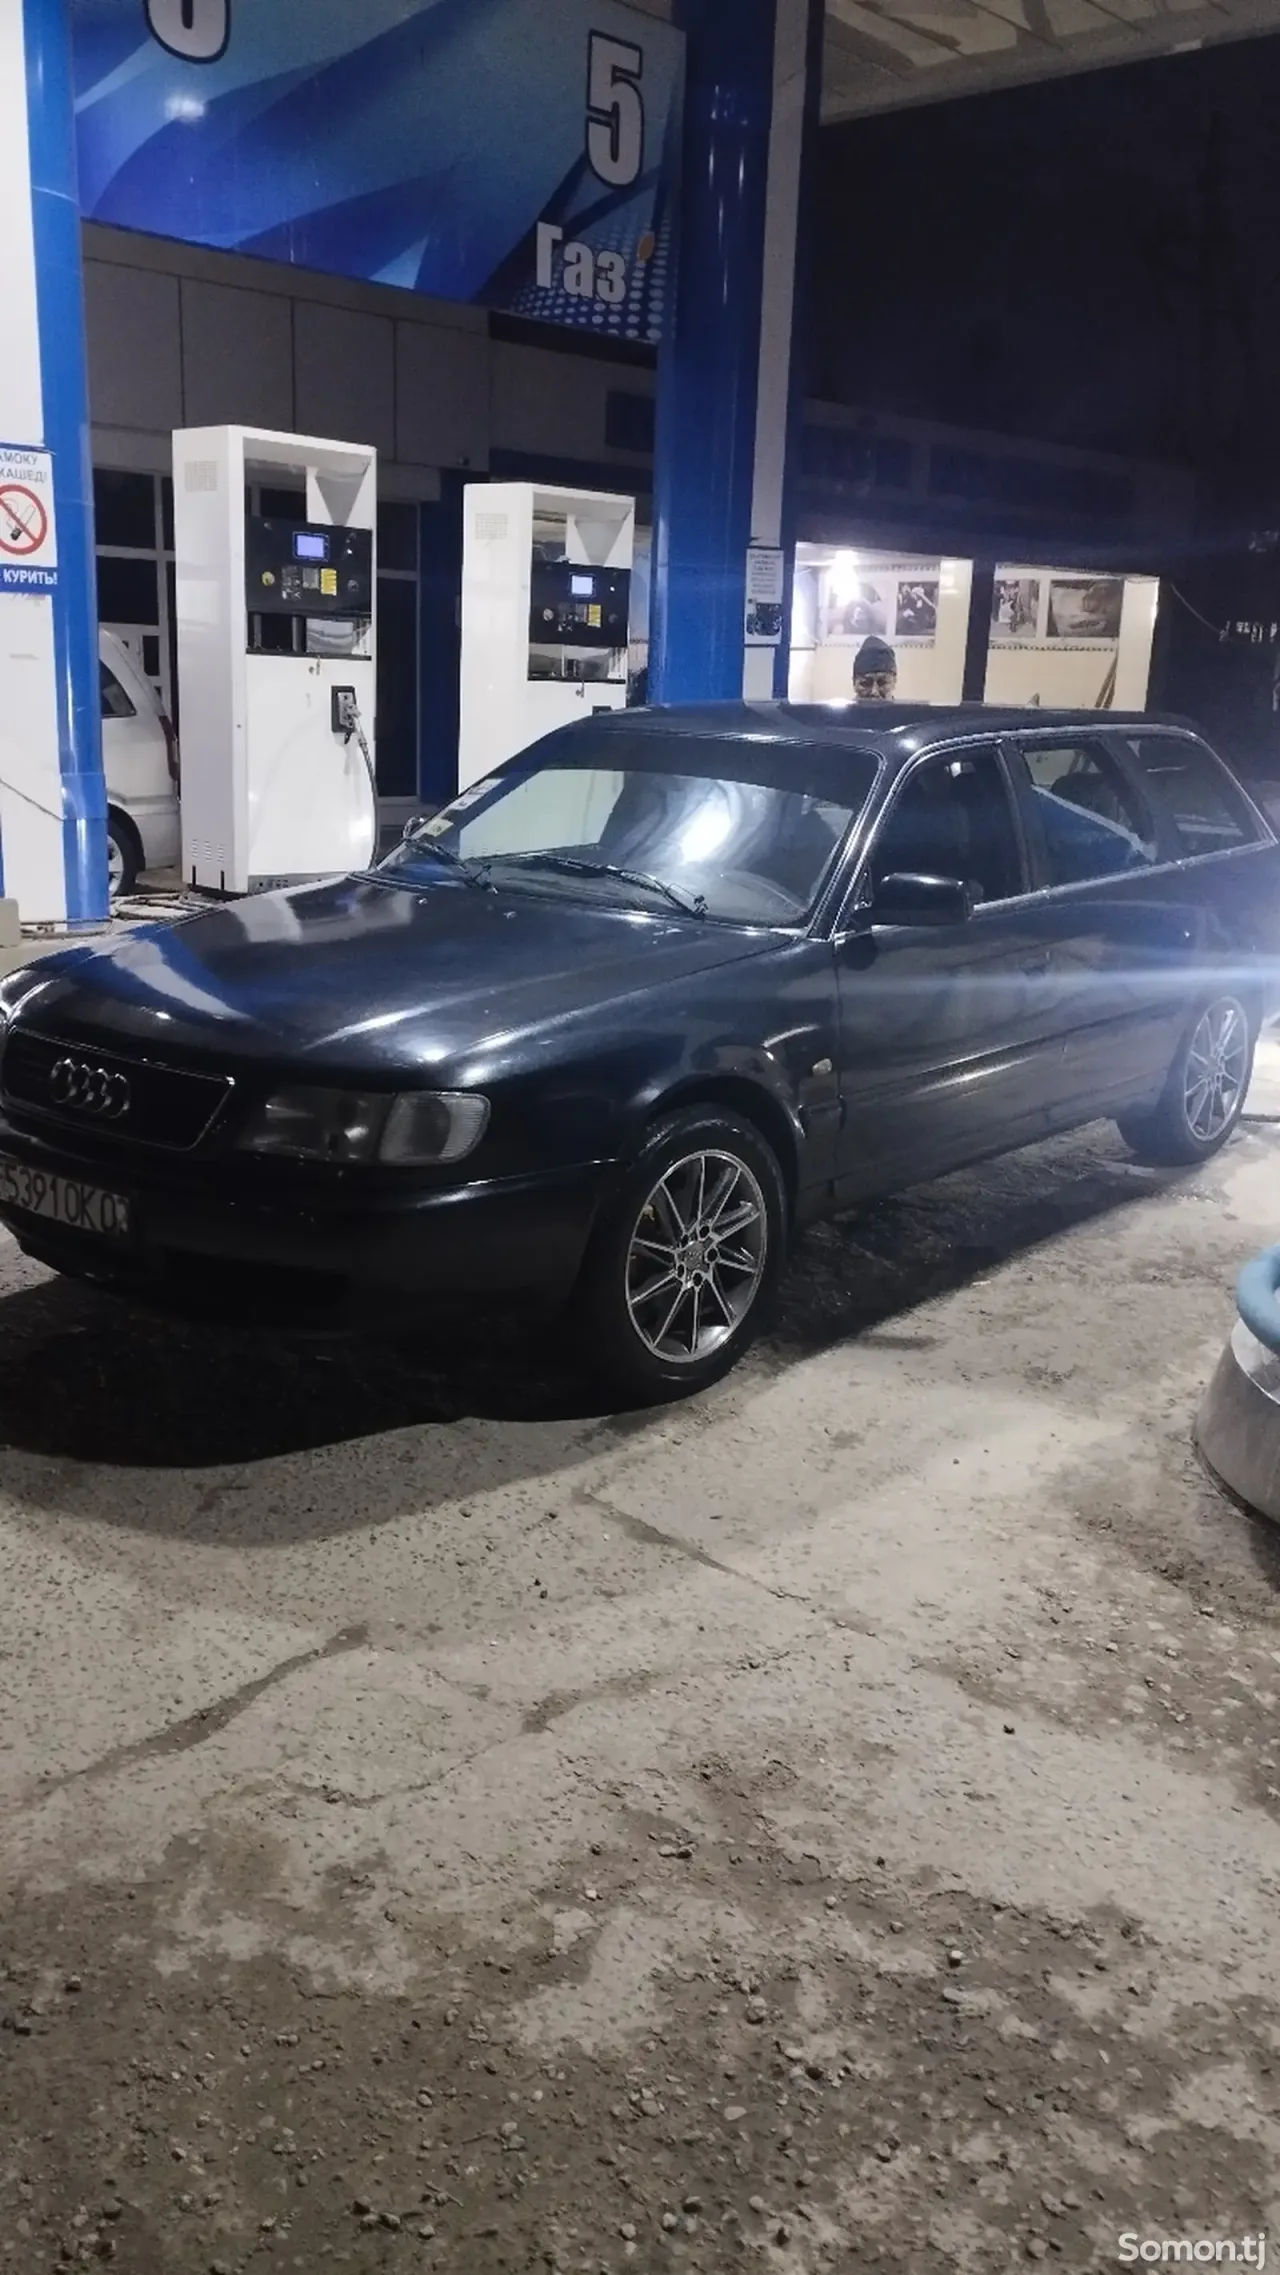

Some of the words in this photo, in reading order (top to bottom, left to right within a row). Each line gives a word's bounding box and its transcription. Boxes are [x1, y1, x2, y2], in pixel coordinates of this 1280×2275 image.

[585, 30, 643, 189] 5
[536, 222, 626, 302] Газ
[3, 568, 58, 585] КУРИТЬ!
